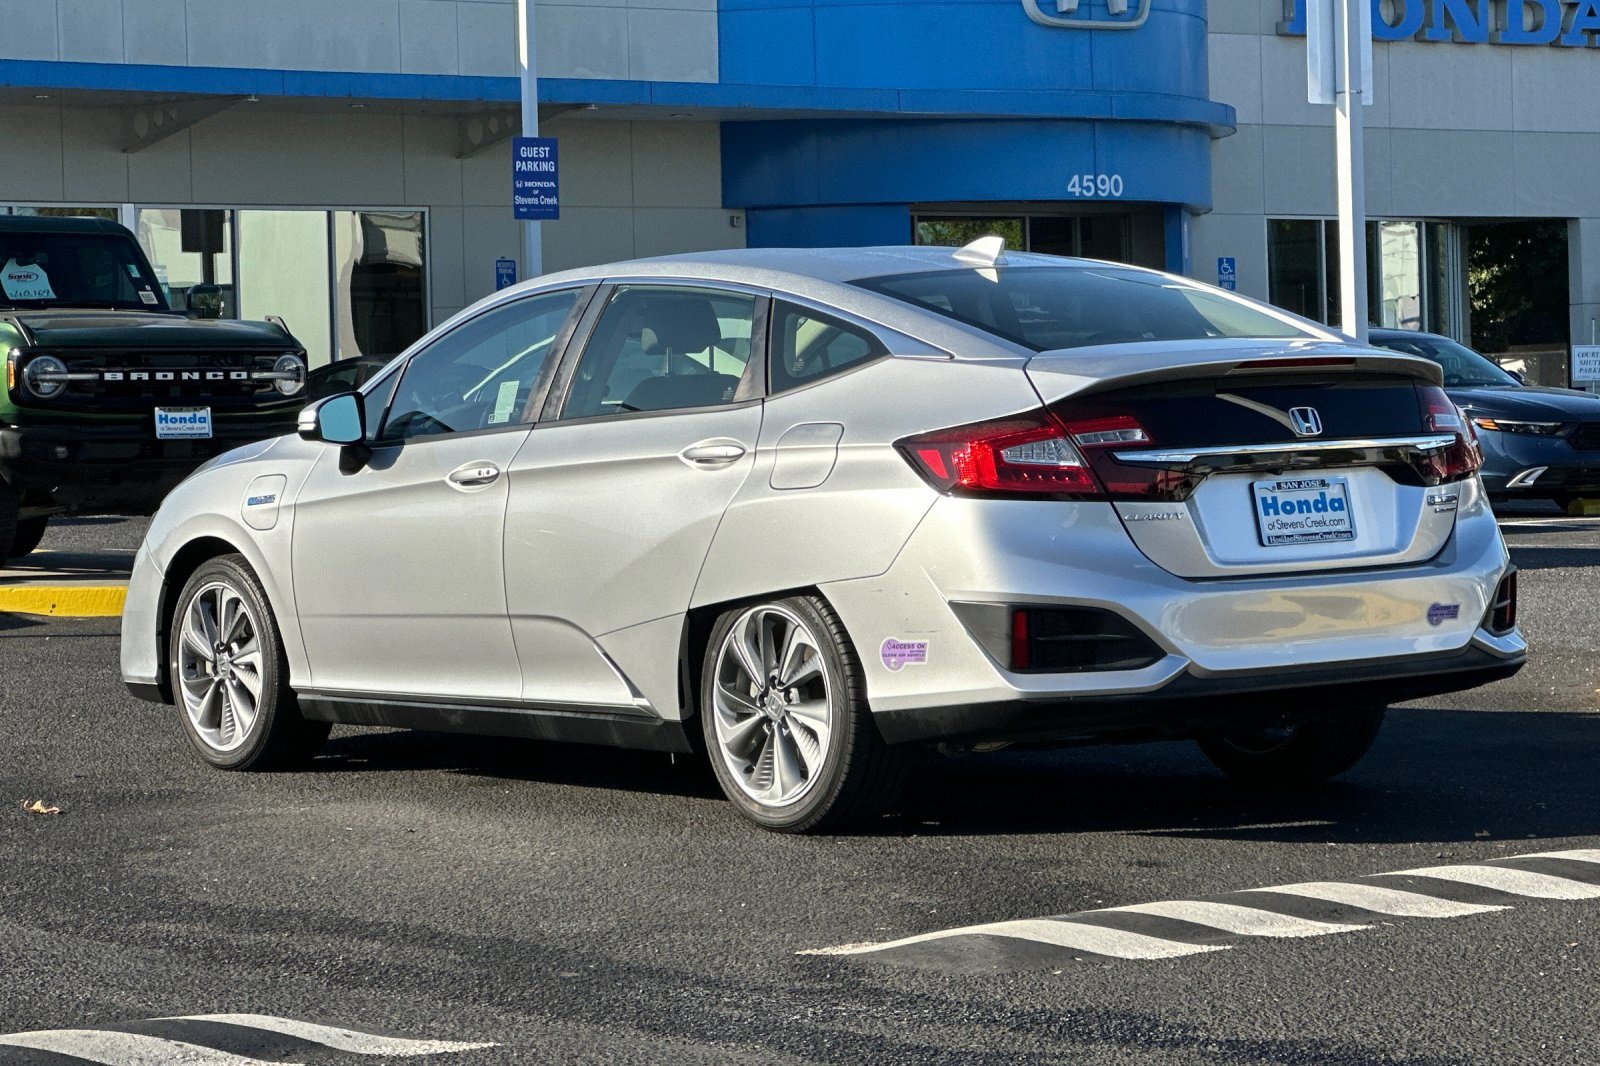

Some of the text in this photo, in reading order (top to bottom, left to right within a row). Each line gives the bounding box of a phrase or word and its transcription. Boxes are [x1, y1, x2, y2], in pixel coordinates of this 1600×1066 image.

[520, 146, 550, 158] GUEST
[515, 160, 555, 172] PARKING
[1067, 174, 1124, 197] 4590
[514, 195, 558, 205] Stevens Creek
[8, 272, 33, 280] Sonic
[104, 371, 248, 381] BRONCO
[158, 413, 207, 424] Honda
[1280, 480, 1323, 490] SAN JOSE
[1260, 491, 1345, 517] Honda
[1124, 512, 1185, 521] CLARITY
[1268, 520, 1276, 531] of
